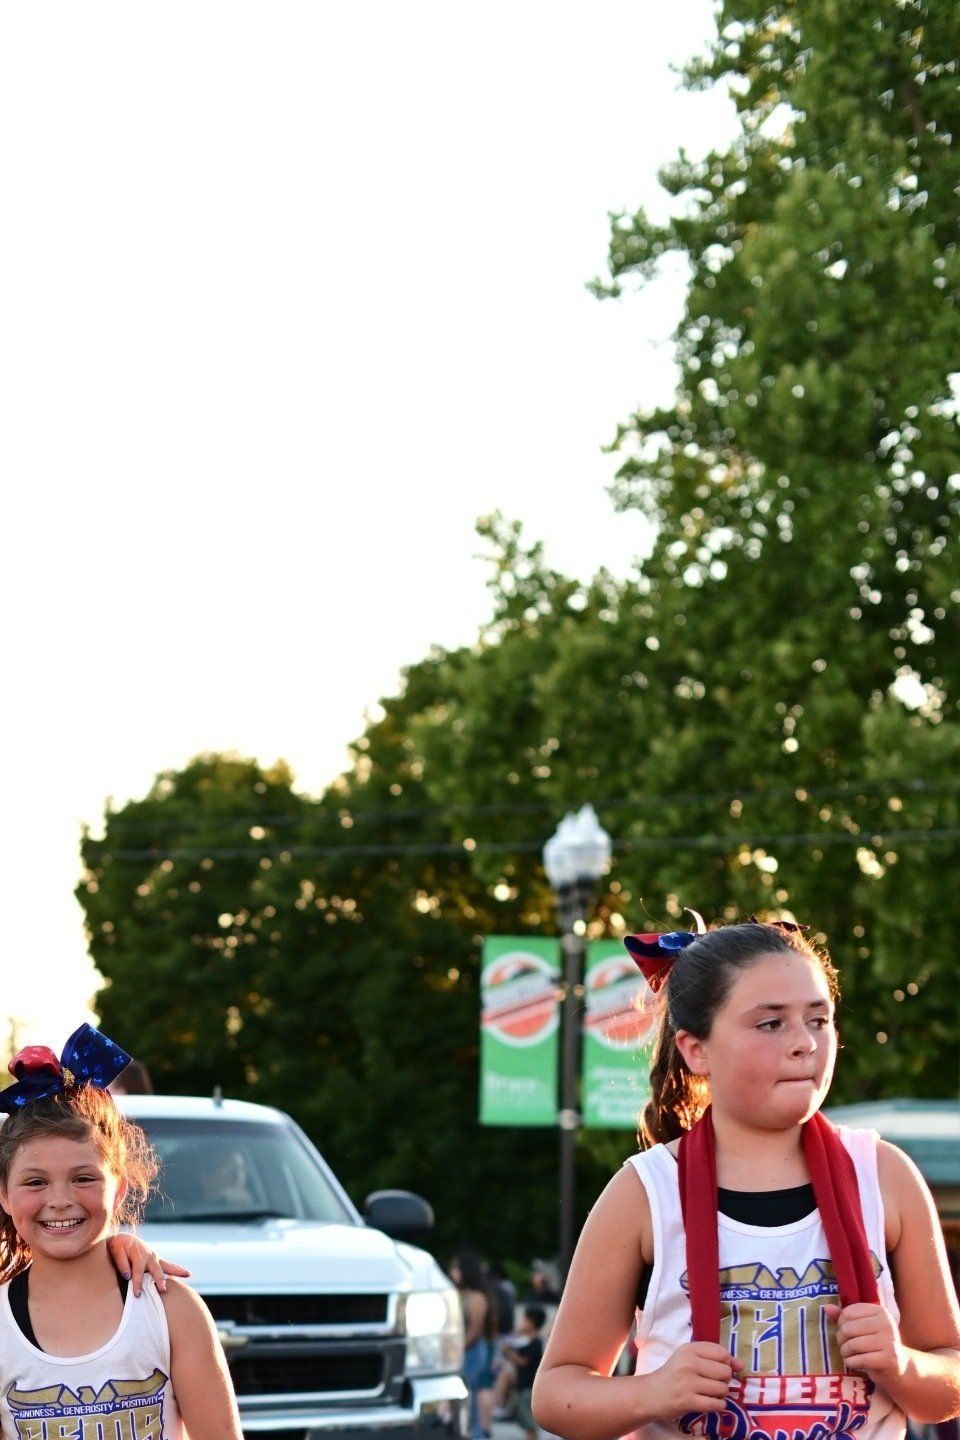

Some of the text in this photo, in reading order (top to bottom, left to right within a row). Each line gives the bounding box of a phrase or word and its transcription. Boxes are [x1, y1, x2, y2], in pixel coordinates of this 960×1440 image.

[759, 1284, 820, 1299] GENEROSITY
[19, 1395, 159, 1418] KINDNESS GENEROSITY POSITIVITY
